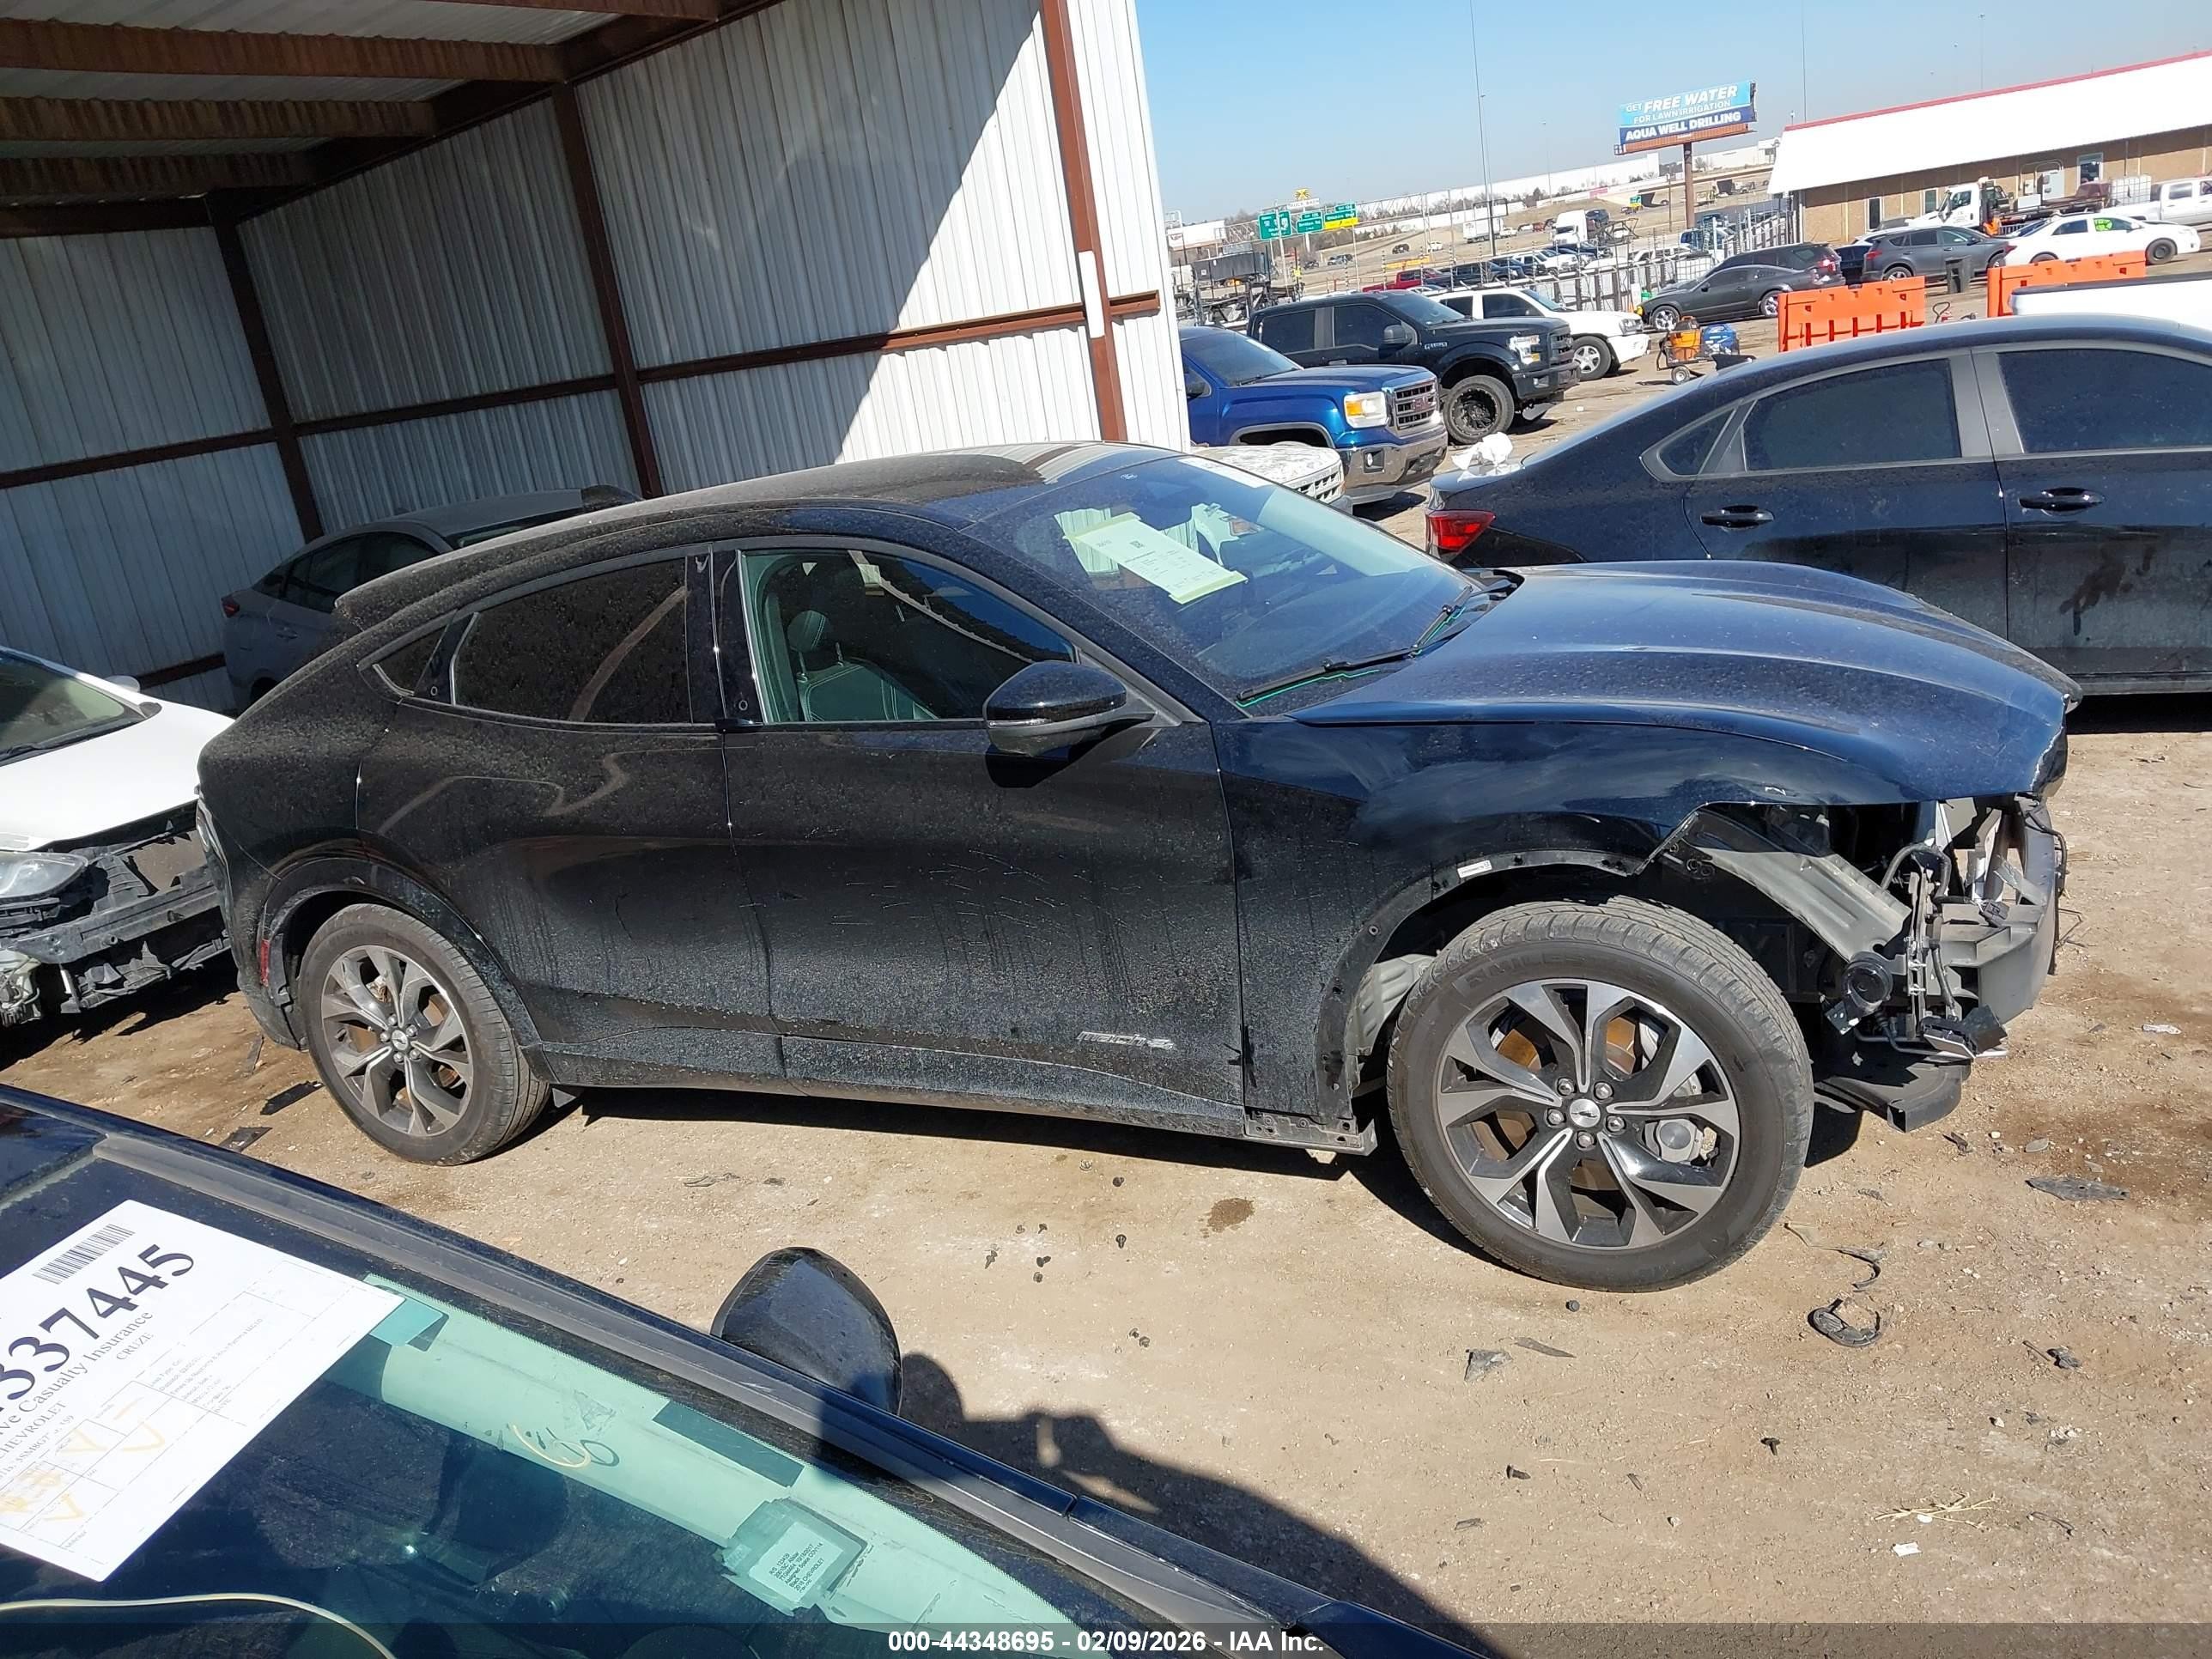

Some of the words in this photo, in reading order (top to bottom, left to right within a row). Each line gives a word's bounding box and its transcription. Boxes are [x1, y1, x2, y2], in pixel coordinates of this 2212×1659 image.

[1626, 103, 1643, 112] GET
[1644, 96, 1681, 113] FREE
[1685, 85, 1738, 106] WATER
[1633, 115, 1651, 125] FOR
[1653, 110, 1679, 121] LAWN
[1680, 100, 1731, 116] IRRIGATION
[1626, 127, 1657, 141] AQUA
[1658, 121, 1688, 136] WELL
[1689, 112, 1741, 129] DRILLING
[116, 1333, 154, 1359] CRUZE
[18, 1362, 88, 1413] Casualty
[82, 1312, 153, 1361] Insurance
[802, 1558, 824, 1582] CHEVROLET
